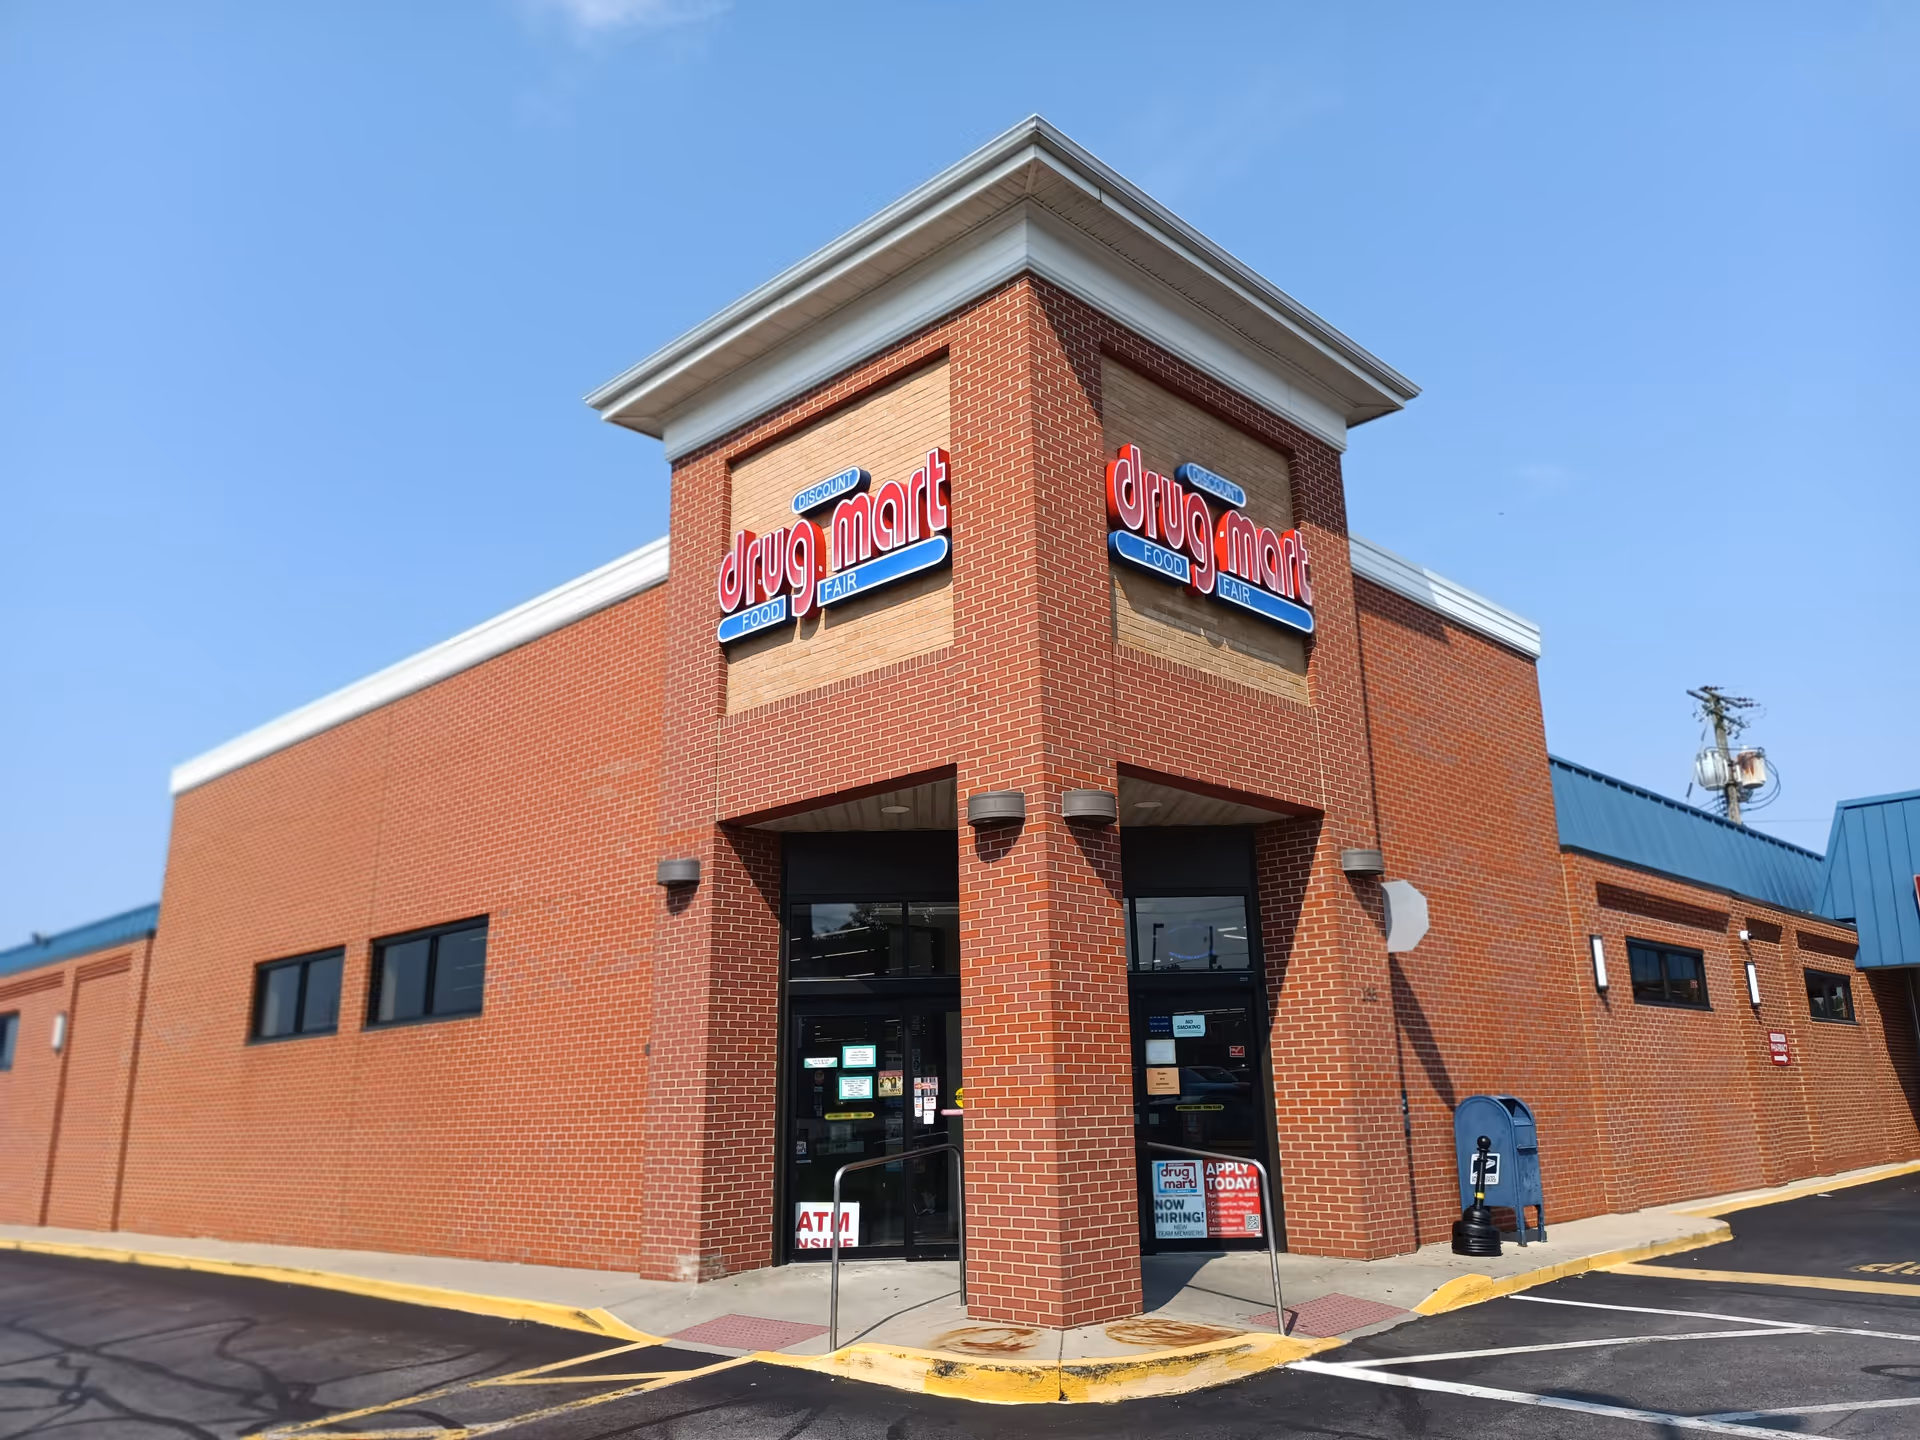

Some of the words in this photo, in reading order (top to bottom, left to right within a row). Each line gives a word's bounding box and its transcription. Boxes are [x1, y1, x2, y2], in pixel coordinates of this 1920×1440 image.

[798, 471, 852, 509] DISCOUNT
[1192, 468, 1240, 500] DISCOUNT
[719, 518, 818, 618] drug
[831, 447, 949, 572] mart
[1112, 443, 1216, 595] drug
[1225, 509, 1313, 606] mart
[1144, 545, 1184, 576] FOOD
[1223, 578, 1252, 605] FAIR
[742, 602, 780, 630] FOOD
[824, 572, 857, 599] FAIR
[1161, 1162, 1190, 1180] drug
[1206, 1162, 1249, 1175] APPLY
[1164, 1176, 1197, 1189] mart
[1206, 1177, 1258, 1190] TODAY!
[1155, 1199, 1184, 1210] NOW
[796, 1211, 850, 1232] ATM
[1155, 1211, 1205, 1223] HIRING!
